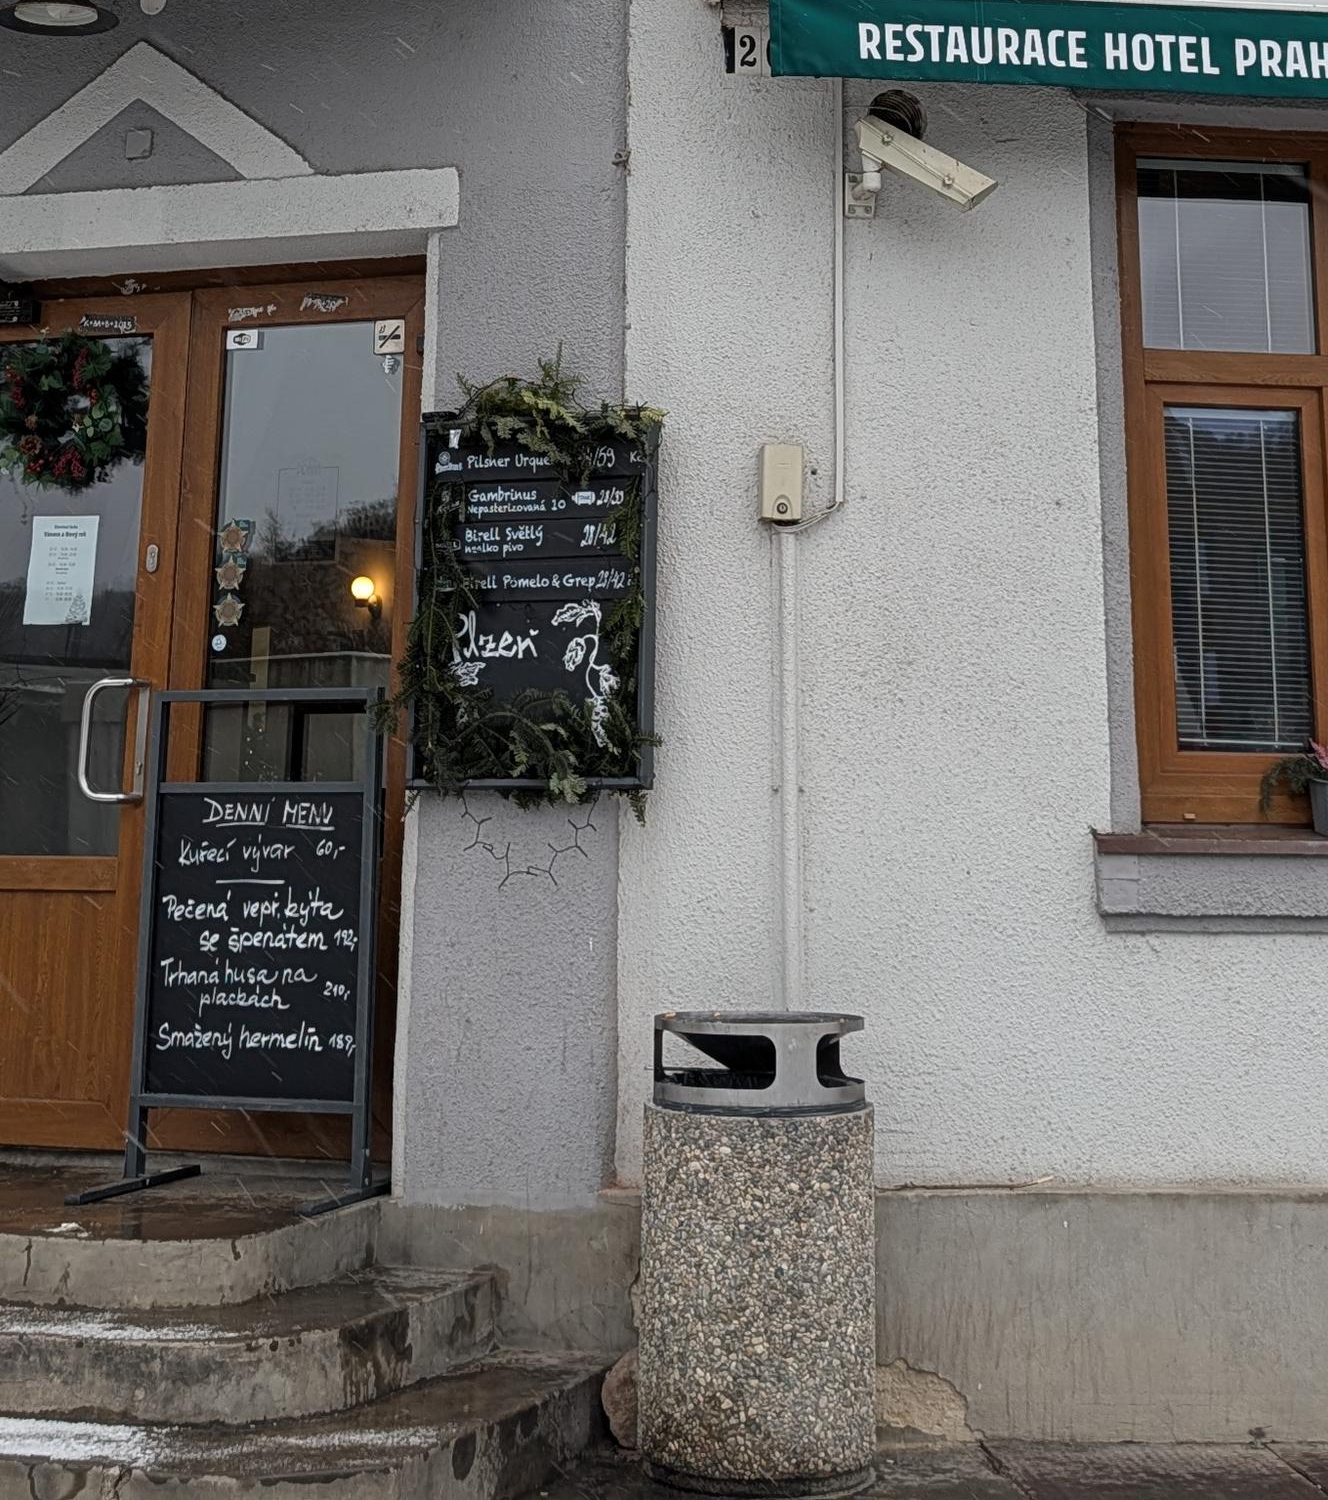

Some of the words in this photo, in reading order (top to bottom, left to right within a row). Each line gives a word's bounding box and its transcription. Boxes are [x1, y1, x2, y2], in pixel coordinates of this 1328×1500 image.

[739, 34, 772, 68] 2
[857, 22, 1088, 70] RESTAURACE
[1103, 31, 1221, 76] HOTEL
[467, 453, 510, 469] Pilsner
[468, 485, 537, 503] Gambrinus
[551, 499, 567, 510] 10
[465, 527, 501, 542] Birell
[505, 524, 544, 546] Světlý
[502, 541, 524, 557] pivo
[503, 574, 550, 588] Pomelo
[551, 574, 561, 589] &
[562, 573, 596, 592] Grep
[202, 796, 276, 824] DENNÍ
[282, 799, 334, 825] MENU
[178, 837, 237, 867] Kuřecí
[242, 833, 295, 873] vývar
[162, 888, 232, 922] Pečená
[199, 929, 220, 952] se
[227, 922, 329, 953] špenátem
[160, 956, 220, 988] Trhaná
[224, 958, 279, 985] husa
[281, 966, 318, 986] na
[198, 984, 291, 1018] plackách
[156, 1021, 233, 1060] Smažený
[238, 1020, 324, 1052] hermelín
